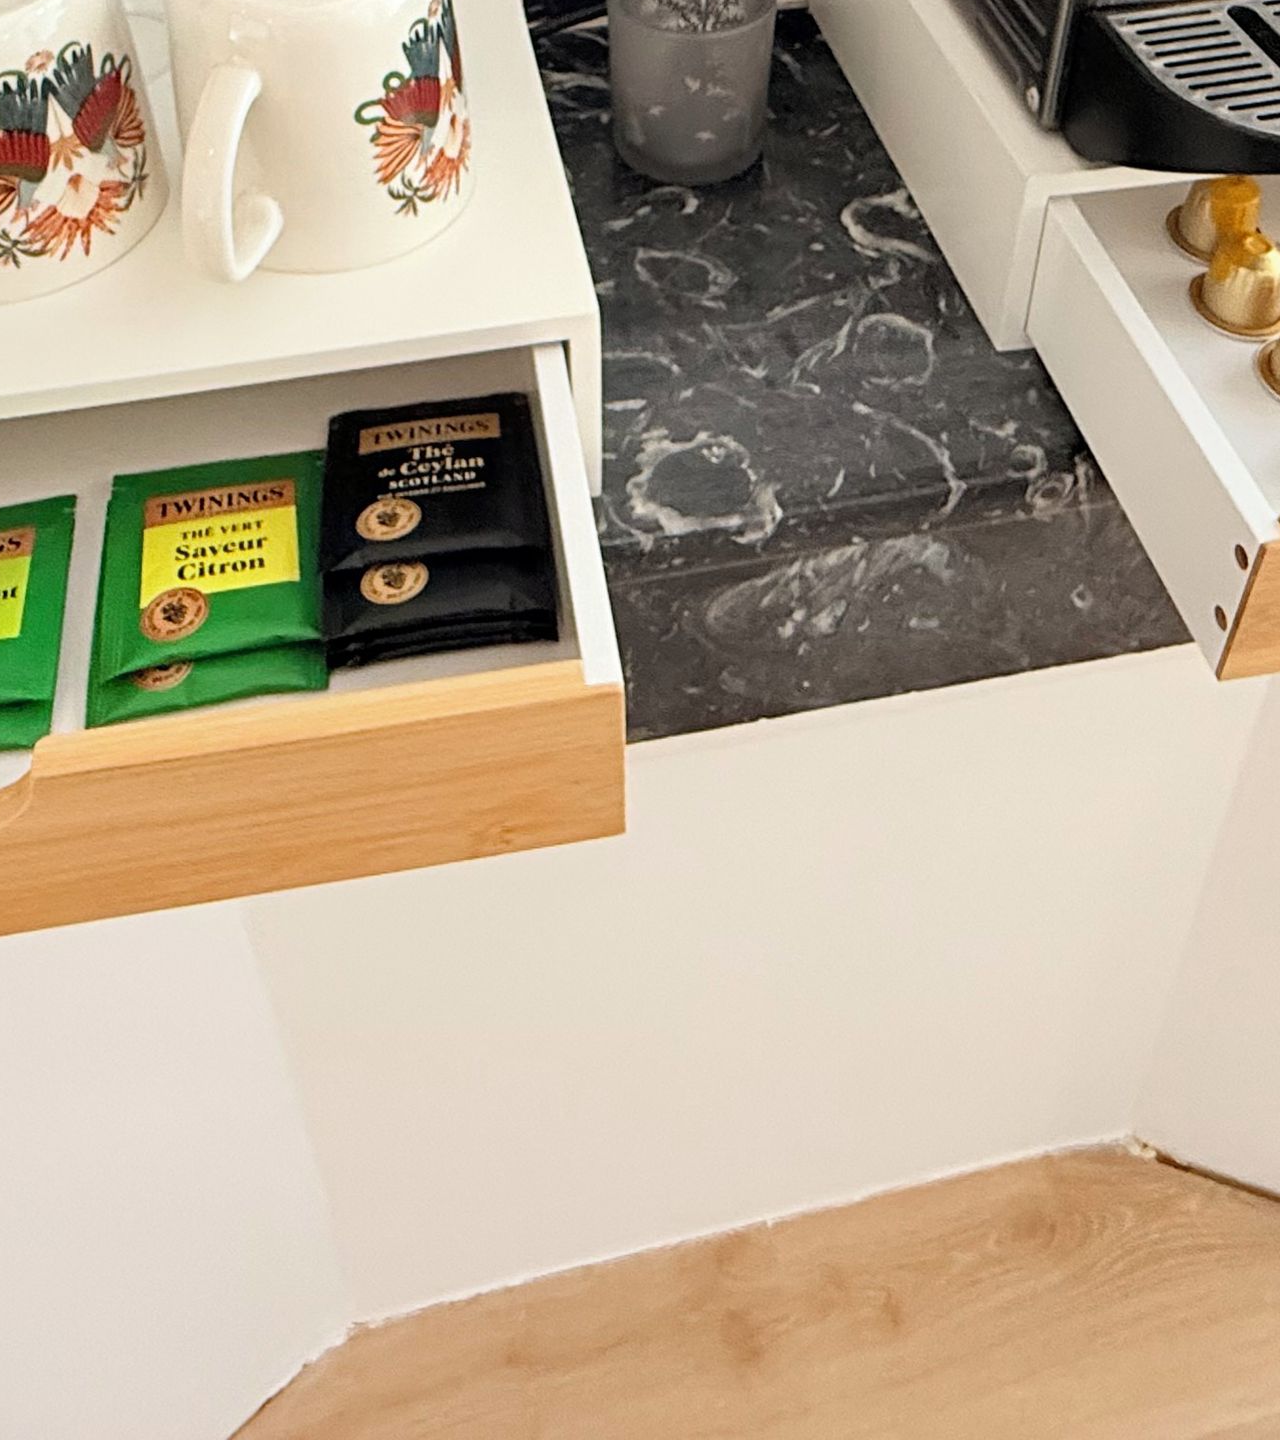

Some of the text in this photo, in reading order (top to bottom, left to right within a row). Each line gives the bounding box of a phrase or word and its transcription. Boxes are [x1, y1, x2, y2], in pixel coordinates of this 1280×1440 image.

[373, 419, 490, 445] TWININGS
[156, 485, 285, 518] TWININGS
[220, 519, 263, 534] VERT
[175, 536, 267, 561] Saveur
[177, 557, 265, 581] Citron
